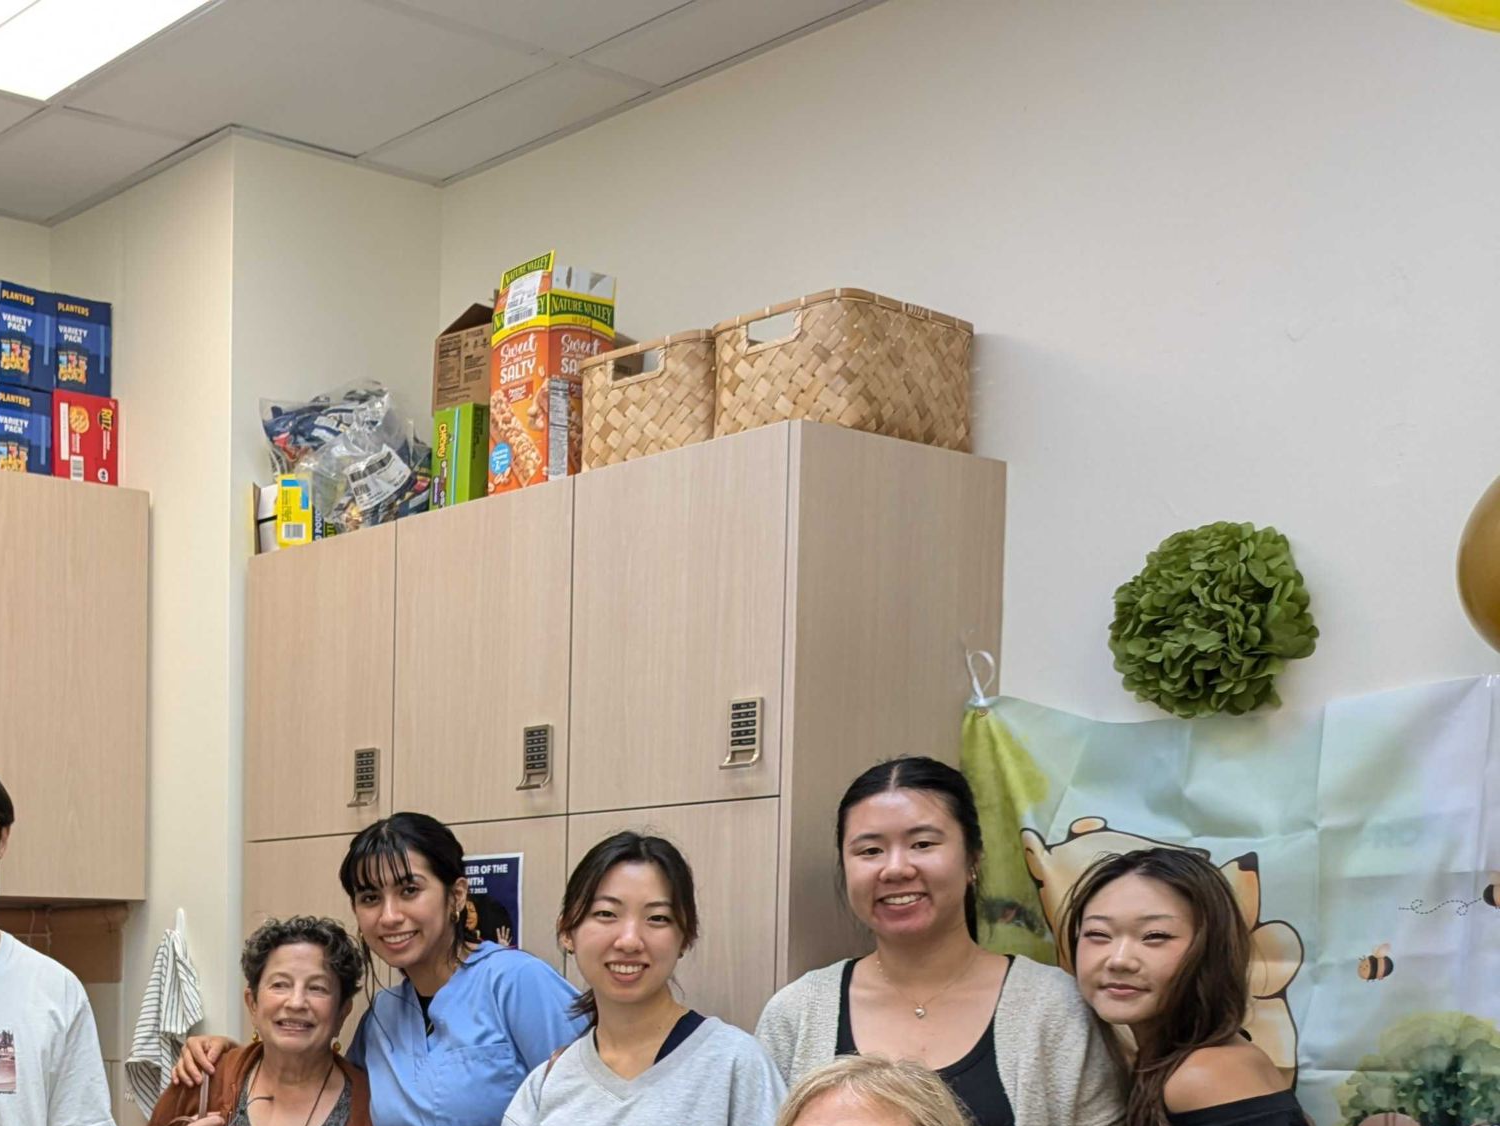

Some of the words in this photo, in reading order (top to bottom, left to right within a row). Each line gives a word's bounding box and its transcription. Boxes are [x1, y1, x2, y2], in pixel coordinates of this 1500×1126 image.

[504, 265, 527, 287] NATURE
[528, 257, 549, 273] VALLEY
[1, 289, 34, 306] PLANTERS
[57, 302, 90, 317] PLANTERS
[551, 296, 583, 314] NATURE
[584, 302, 613, 325] VALLEY
[2, 313, 33, 327] VARIETY
[8, 322, 27, 333] PACK
[58, 325, 88, 338] VARIETY
[64, 333, 83, 344] PACK
[500, 333, 538, 363] Sweet
[561, 334, 601, 356] Sweet
[500, 357, 536, 385] SALTY
[561, 357, 577, 375] SA
[0, 415, 29, 428] VARIETY
[101, 408, 113, 431] RITZ
[4, 424, 23, 434] PACK
[465, 865, 479, 875] EER
[480, 864, 491, 874] OF
[492, 863, 508, 874] THE
[468, 877, 484, 886] NTH
